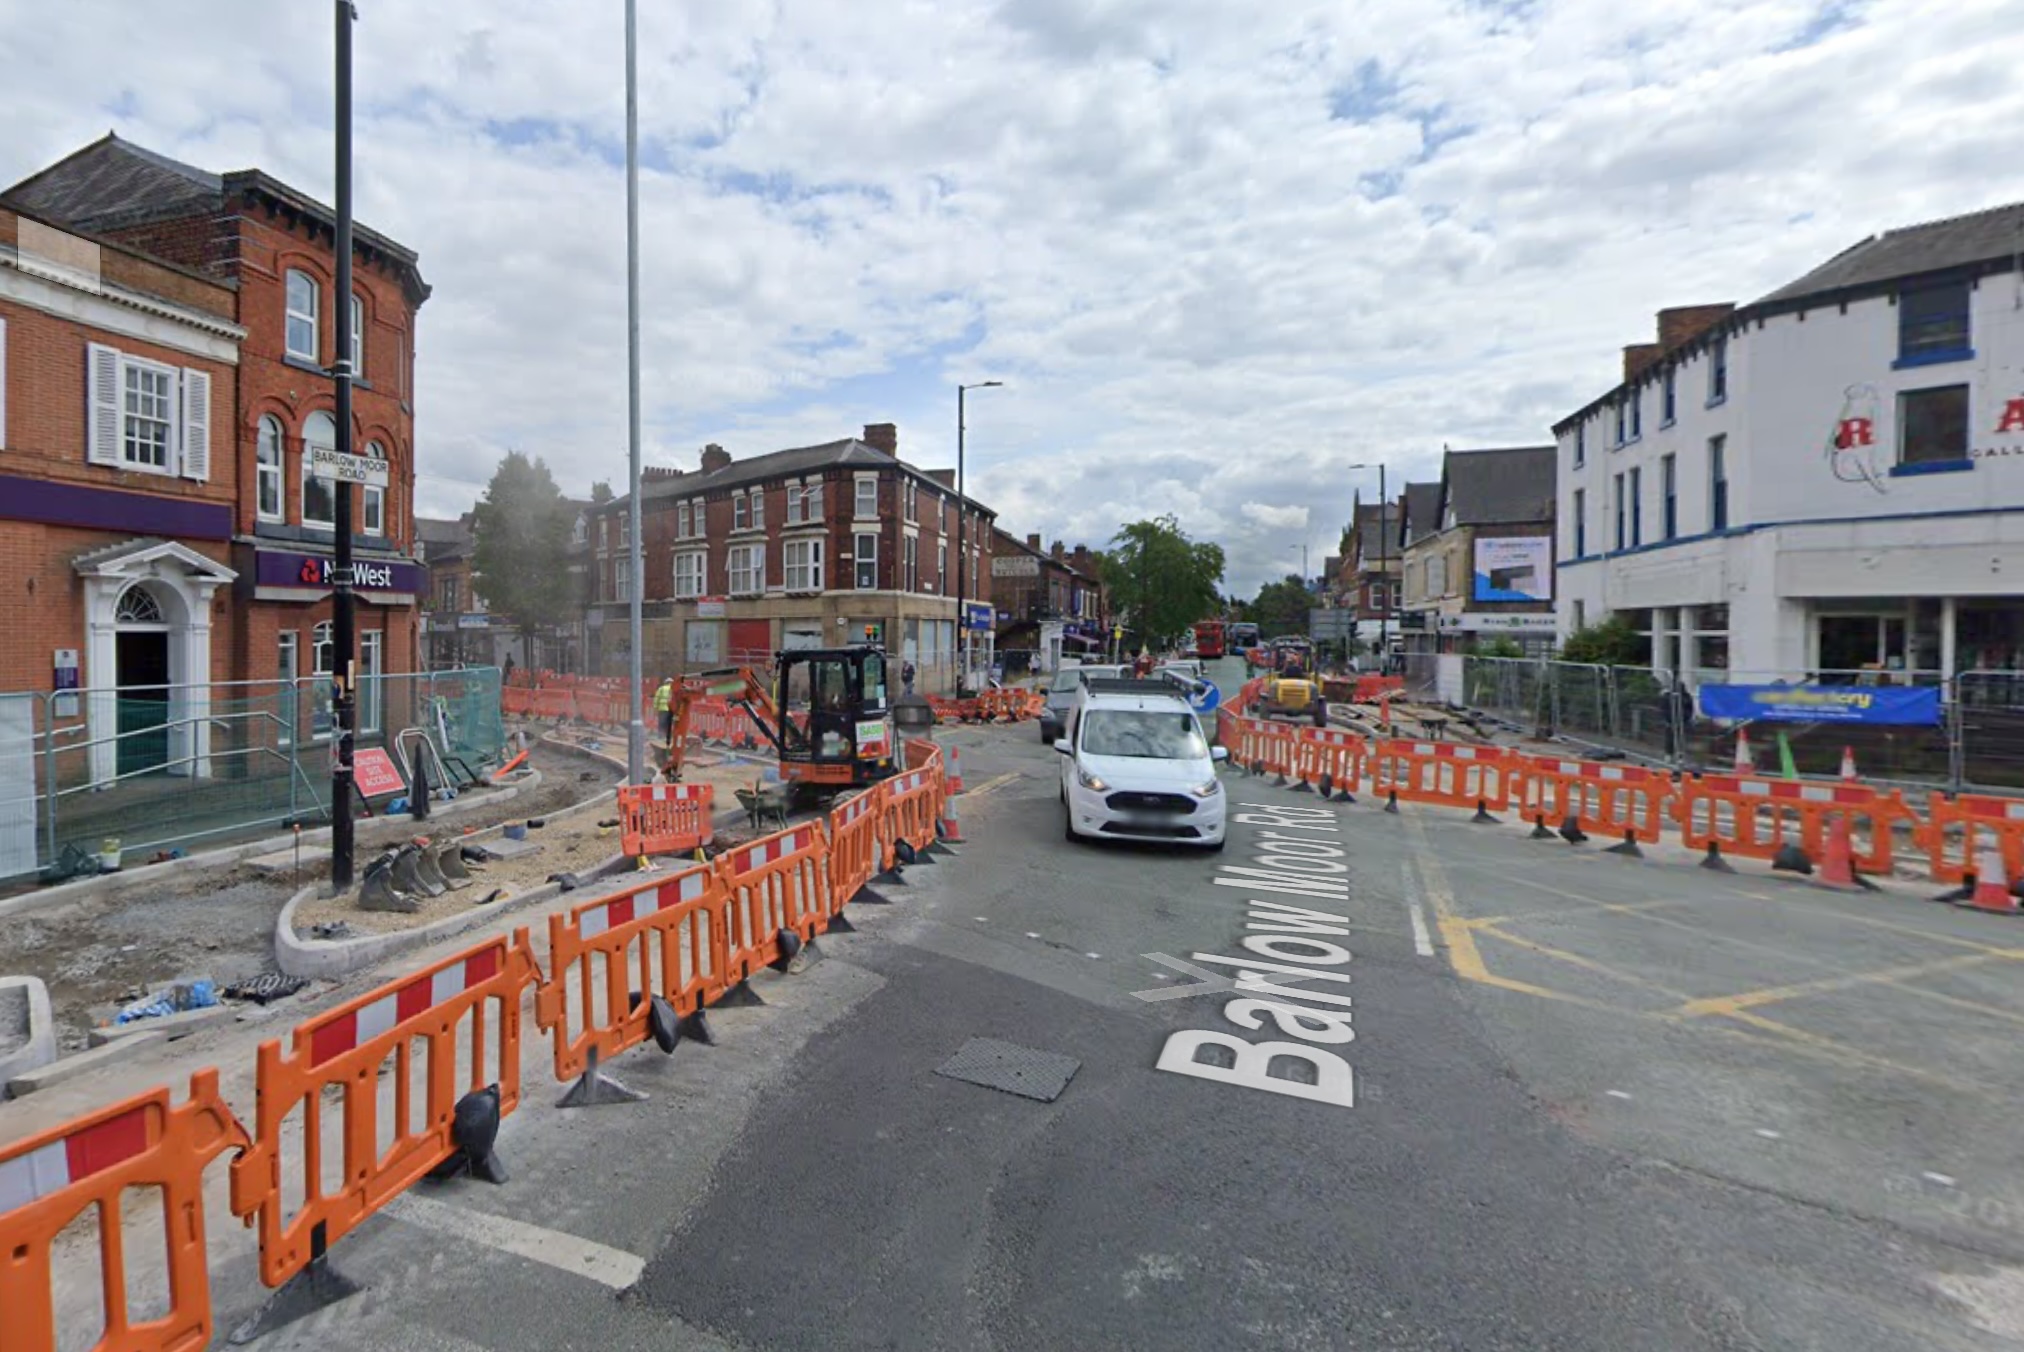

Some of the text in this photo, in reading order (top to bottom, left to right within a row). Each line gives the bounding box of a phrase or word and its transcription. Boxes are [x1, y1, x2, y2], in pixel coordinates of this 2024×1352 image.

[314, 449, 387, 473] BARLOW MOOR
[339, 467, 367, 480] ROAD
[324, 560, 392, 587] NWest
